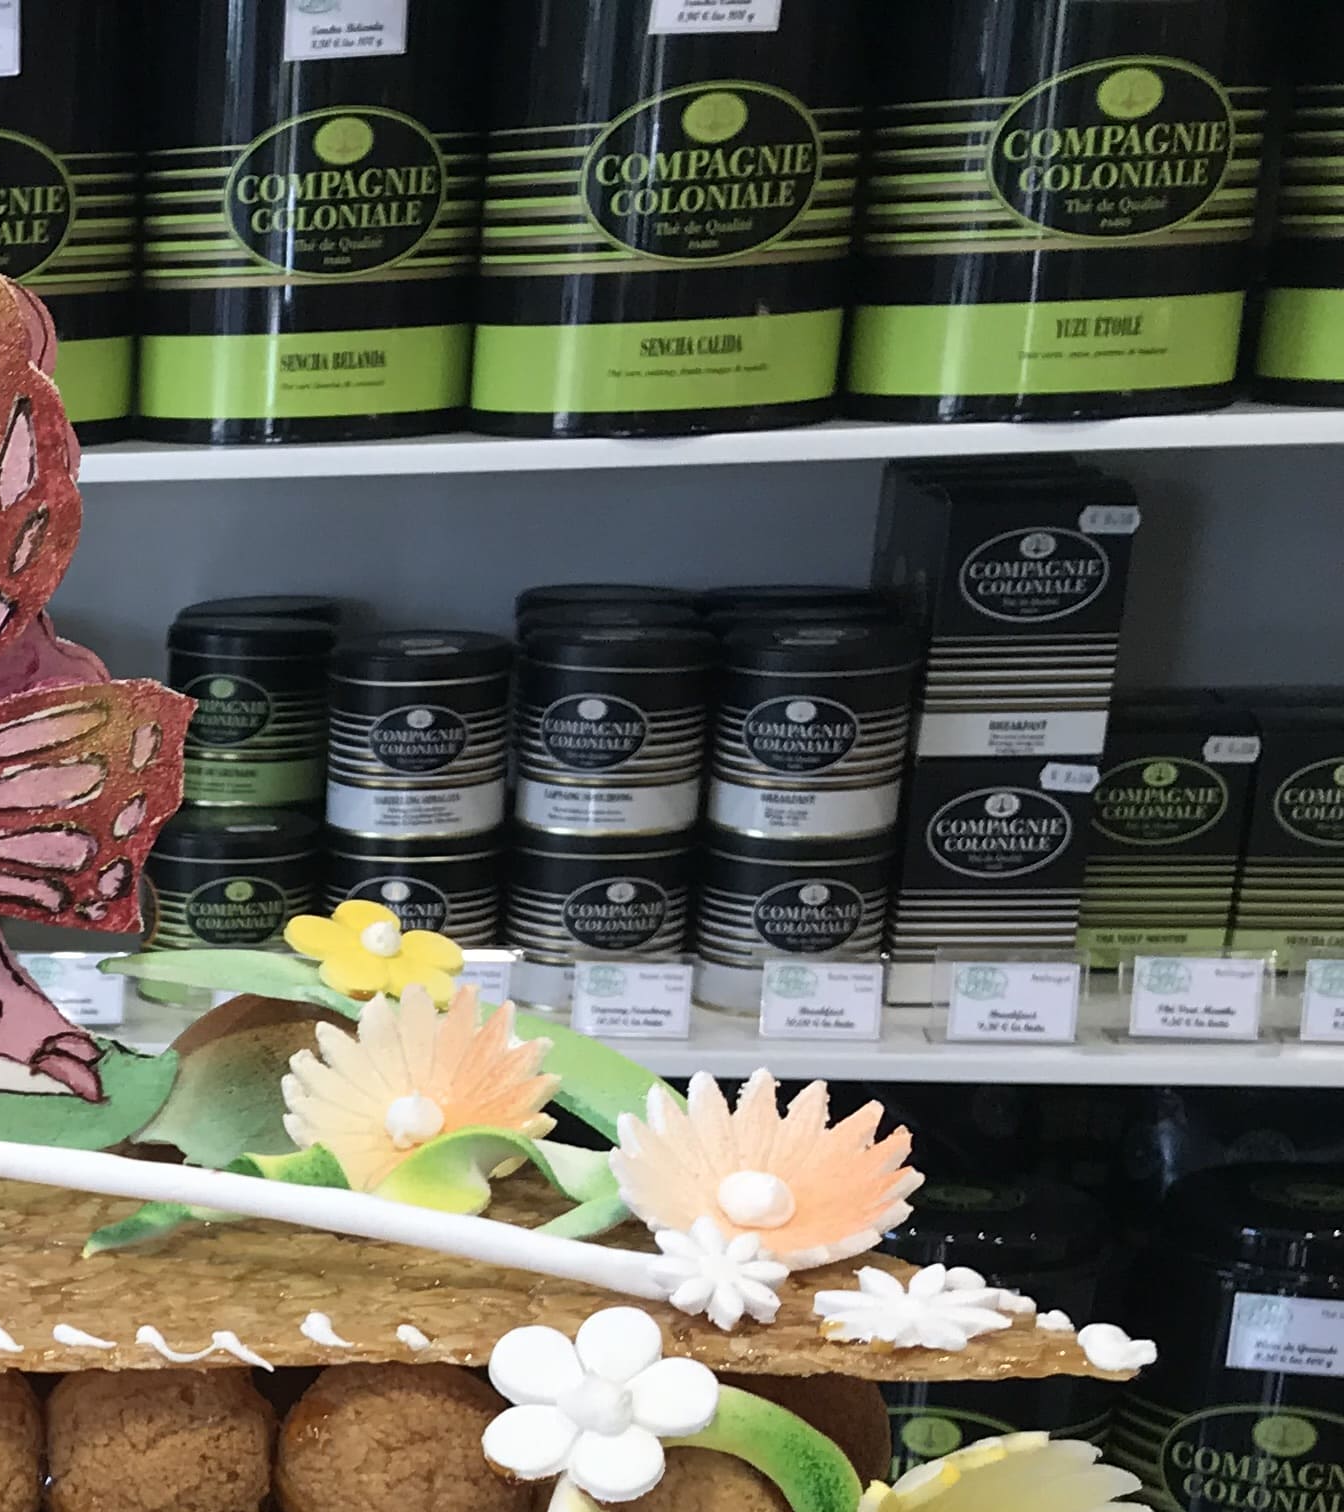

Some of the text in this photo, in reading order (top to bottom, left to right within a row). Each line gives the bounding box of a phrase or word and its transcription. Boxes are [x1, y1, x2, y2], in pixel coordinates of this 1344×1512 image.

[1003, 121, 1229, 162] COMPAGNIE
[595, 144, 812, 185] COMPAGNIE
[1020, 158, 1210, 192] COLONIALE
[236, 165, 438, 205] COMPAGNIE
[611, 181, 795, 216] COLONIALE
[252, 202, 422, 234] COLONIALE
[969, 560, 1102, 579] COMPAGNIE
[978, 578, 1088, 595] COLONIALE
[545, 718, 643, 737] COMPAGNIE
[748, 721, 854, 739] COMPAGNIE
[549, 735, 633, 751] COLONIALE
[753, 737, 843, 754] COLONIALE
[936, 819, 1066, 837] COMPAGNIE
[943, 836, 1051, 854] COLONIALE
[1171, 1441, 1344, 1491] COMPAGN
